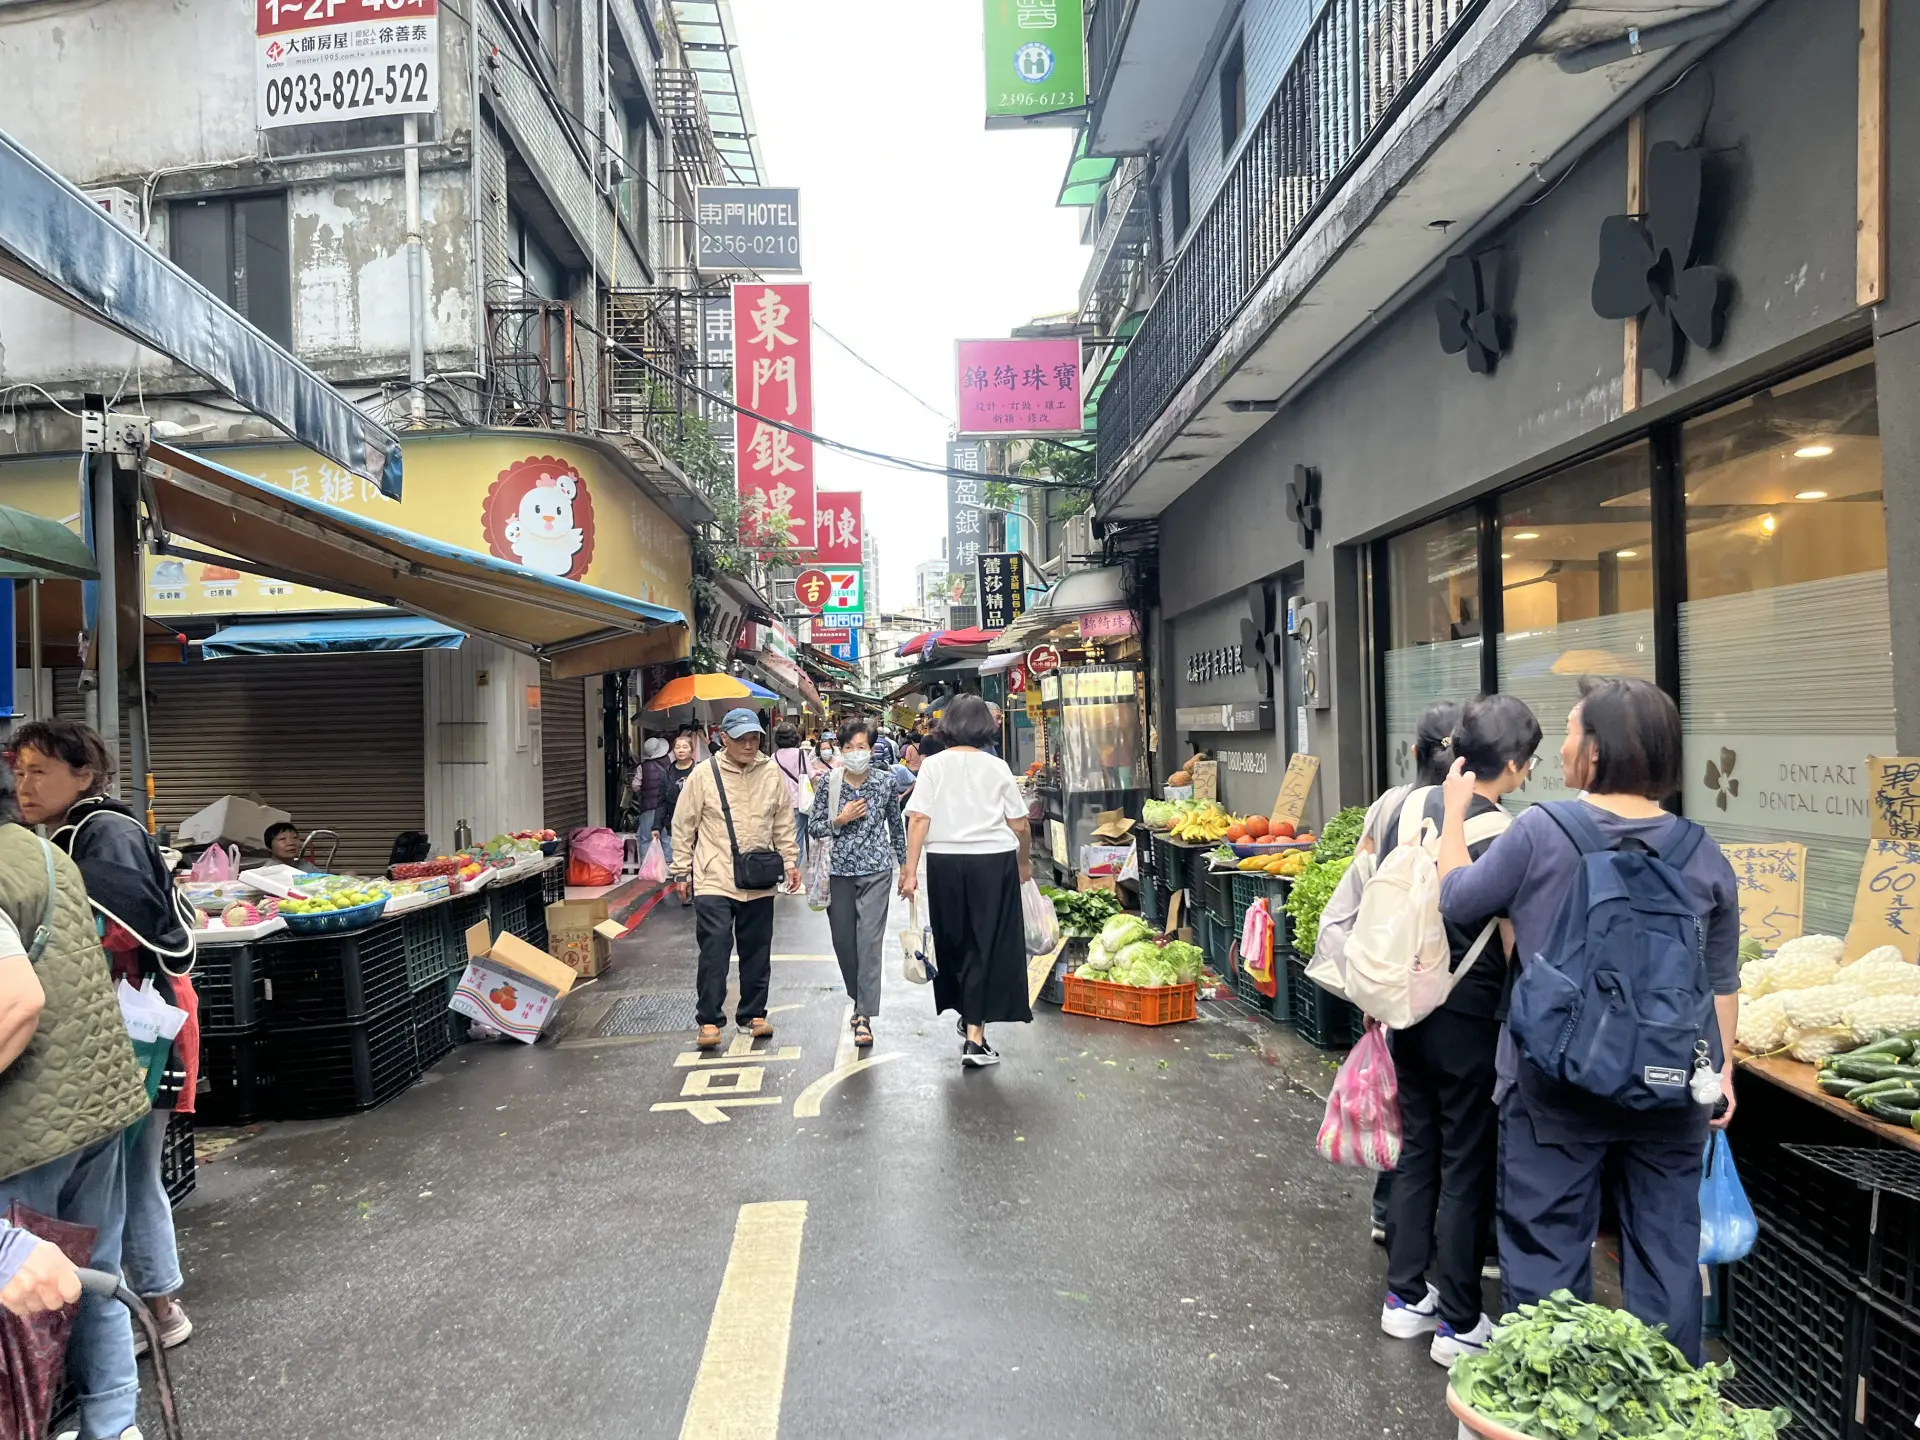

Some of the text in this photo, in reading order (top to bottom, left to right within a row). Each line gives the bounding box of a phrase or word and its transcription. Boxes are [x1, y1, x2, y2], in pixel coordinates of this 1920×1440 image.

[286, 32, 348, 55] 大師房屋
[379, 24, 427, 44] 徐善泰
[266, 62, 429, 117] 0933-822-522
[998, 92, 1075, 107] 2396-6123
[701, 235, 799, 254] 2356-0210
[963, 362, 1077, 392] 錦綺珠寶
[746, 288, 806, 545] 東門銀樓
[953, 447, 981, 567] 福盈銀樓
[802, 575, 825, 603] 吉
[983, 557, 1005, 628] 蕾莎精品
[1759, 791, 1818, 813] DENTAL
[1869, 865, 1917, 893] 60
